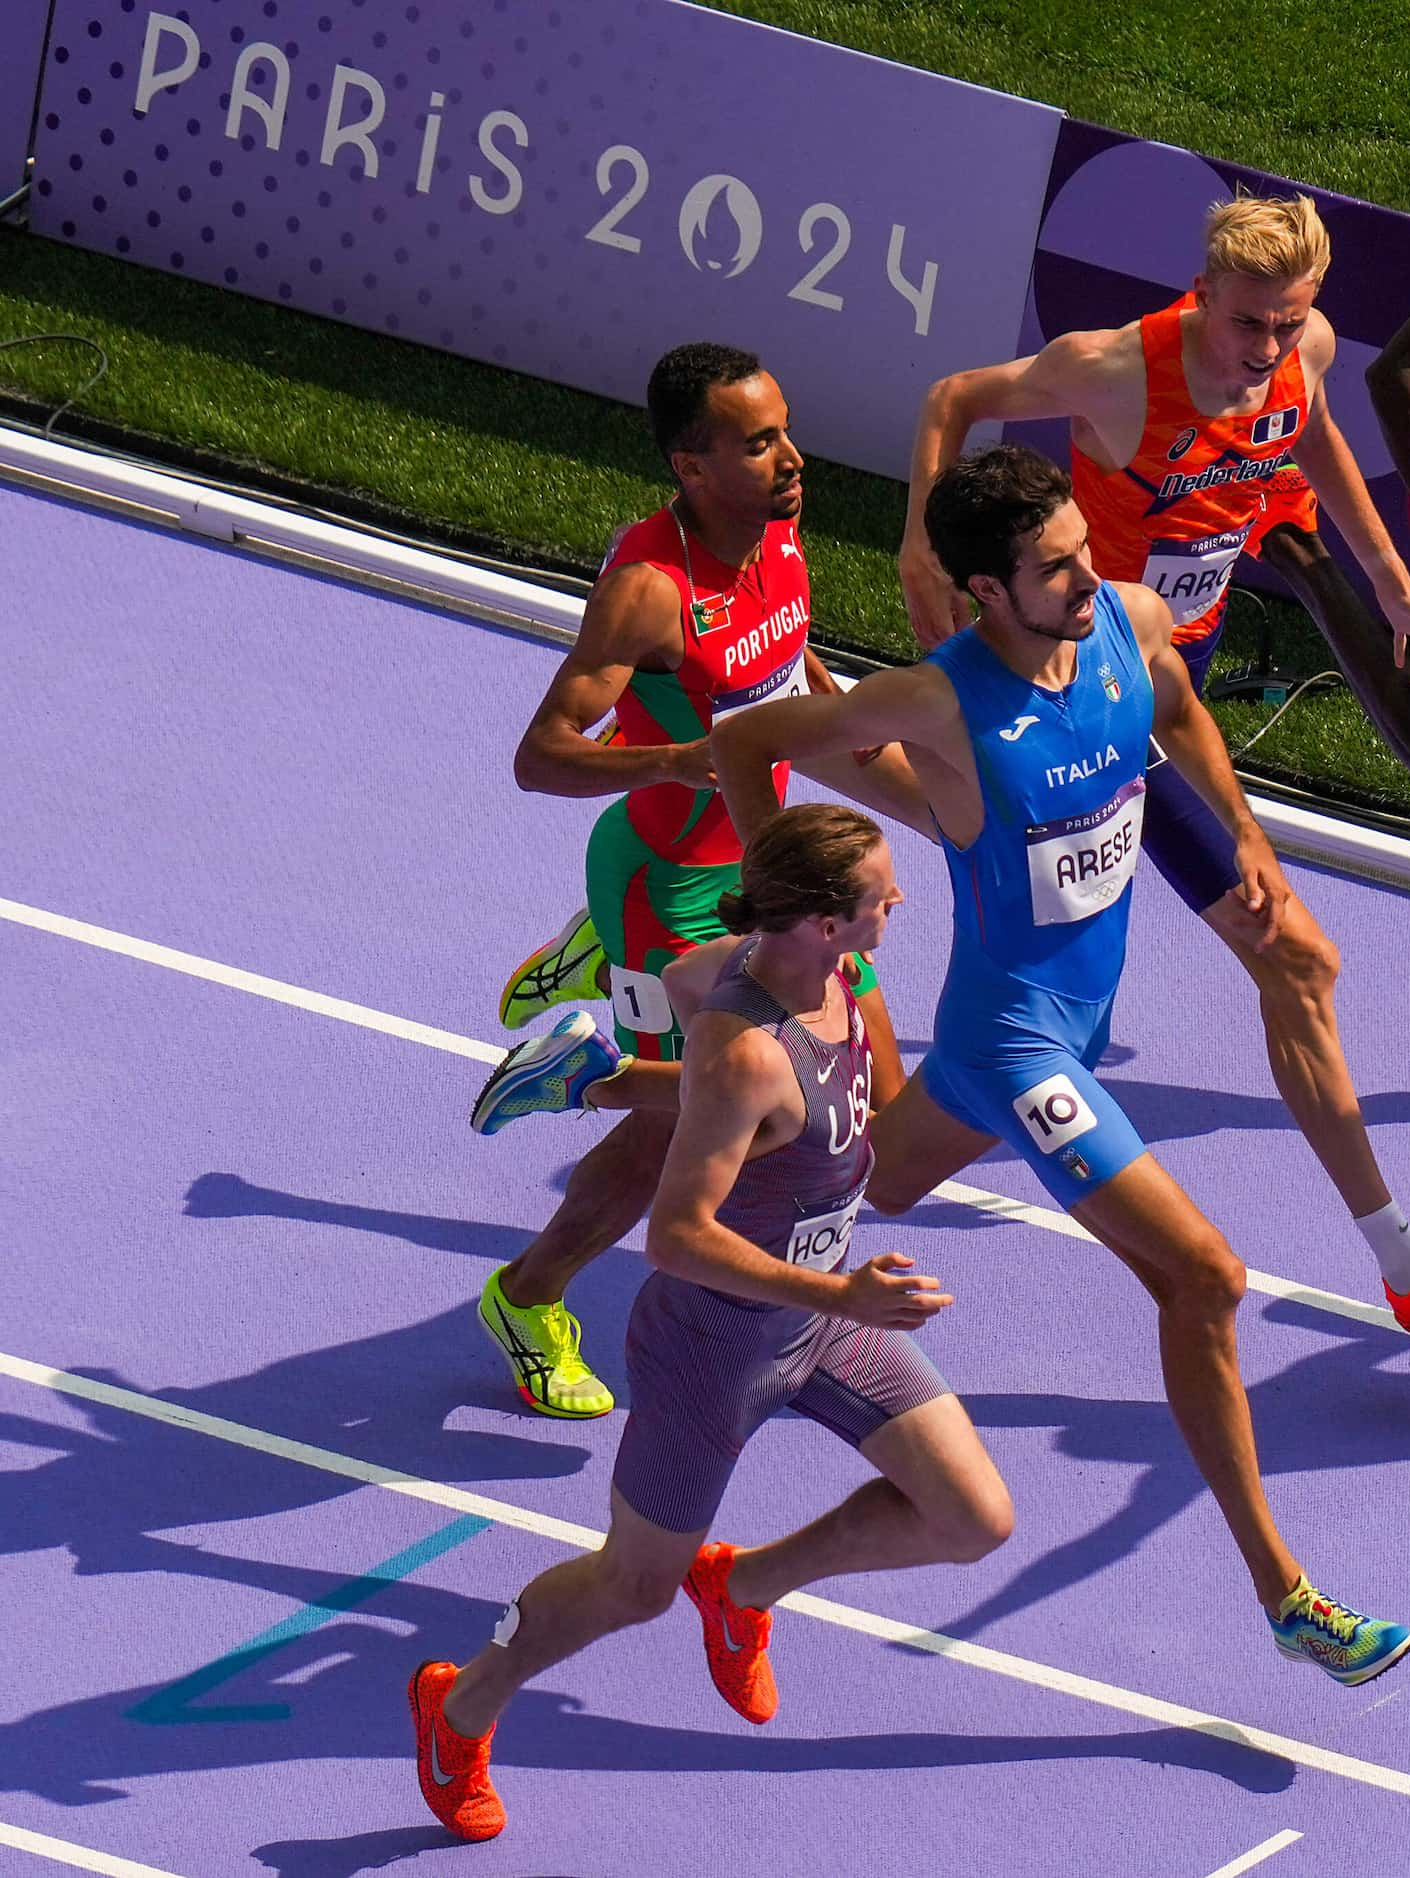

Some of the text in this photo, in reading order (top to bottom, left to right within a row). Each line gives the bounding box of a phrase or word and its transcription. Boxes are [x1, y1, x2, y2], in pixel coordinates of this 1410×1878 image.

[724, 596, 809, 677] PORTUGAL
[748, 677, 775, 700] PARIS
[1045, 744, 1121, 789] ITALIA
[1066, 813, 1101, 830] PARIS
[1056, 820, 1132, 890] ARESE
[623, 985, 641, 1018] 1
[1027, 1092, 1078, 1137] 10
[1296, 1633, 1348, 1669] HOKA
